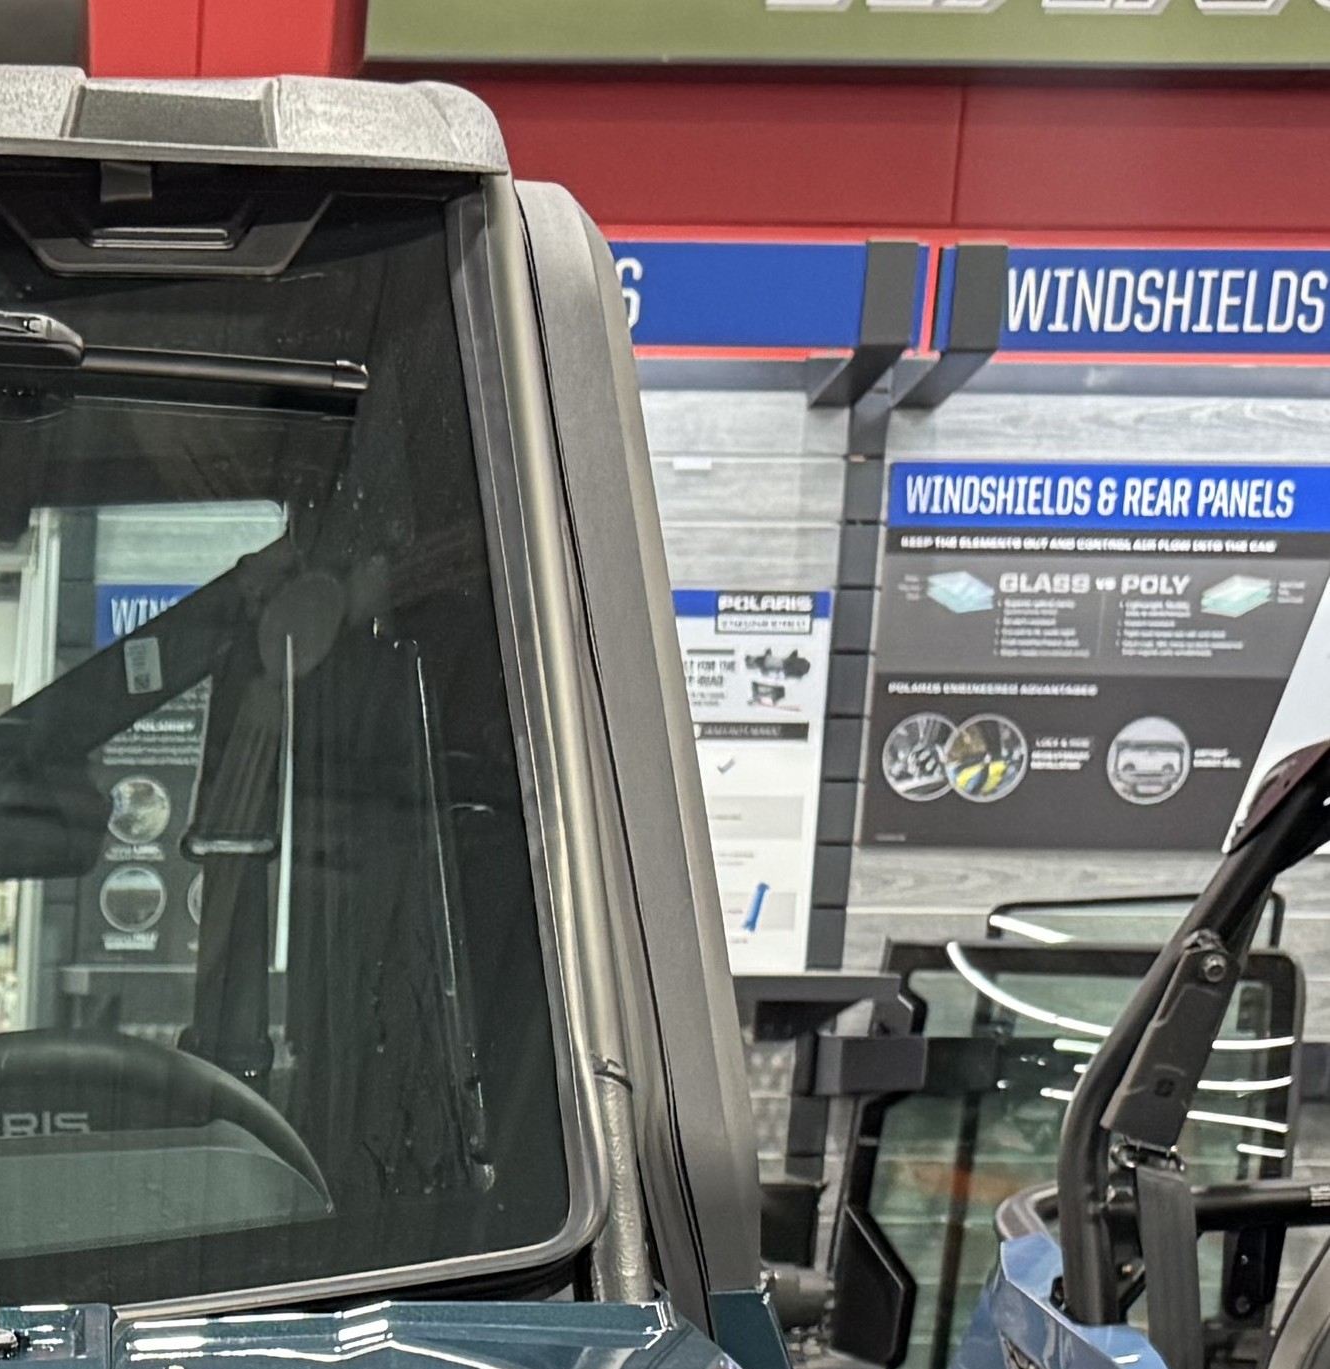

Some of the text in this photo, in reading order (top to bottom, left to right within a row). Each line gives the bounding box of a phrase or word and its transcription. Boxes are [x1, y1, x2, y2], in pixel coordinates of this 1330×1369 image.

[1006, 266, 1328, 335] WINDSHIELDS
[906, 474, 1296, 519] WINDSHIELDS & REAR PANELS
[999, 572, 1091, 595] GLASS
[1120, 573, 1191, 596] POLY
[717, 594, 813, 612] POLARIS
